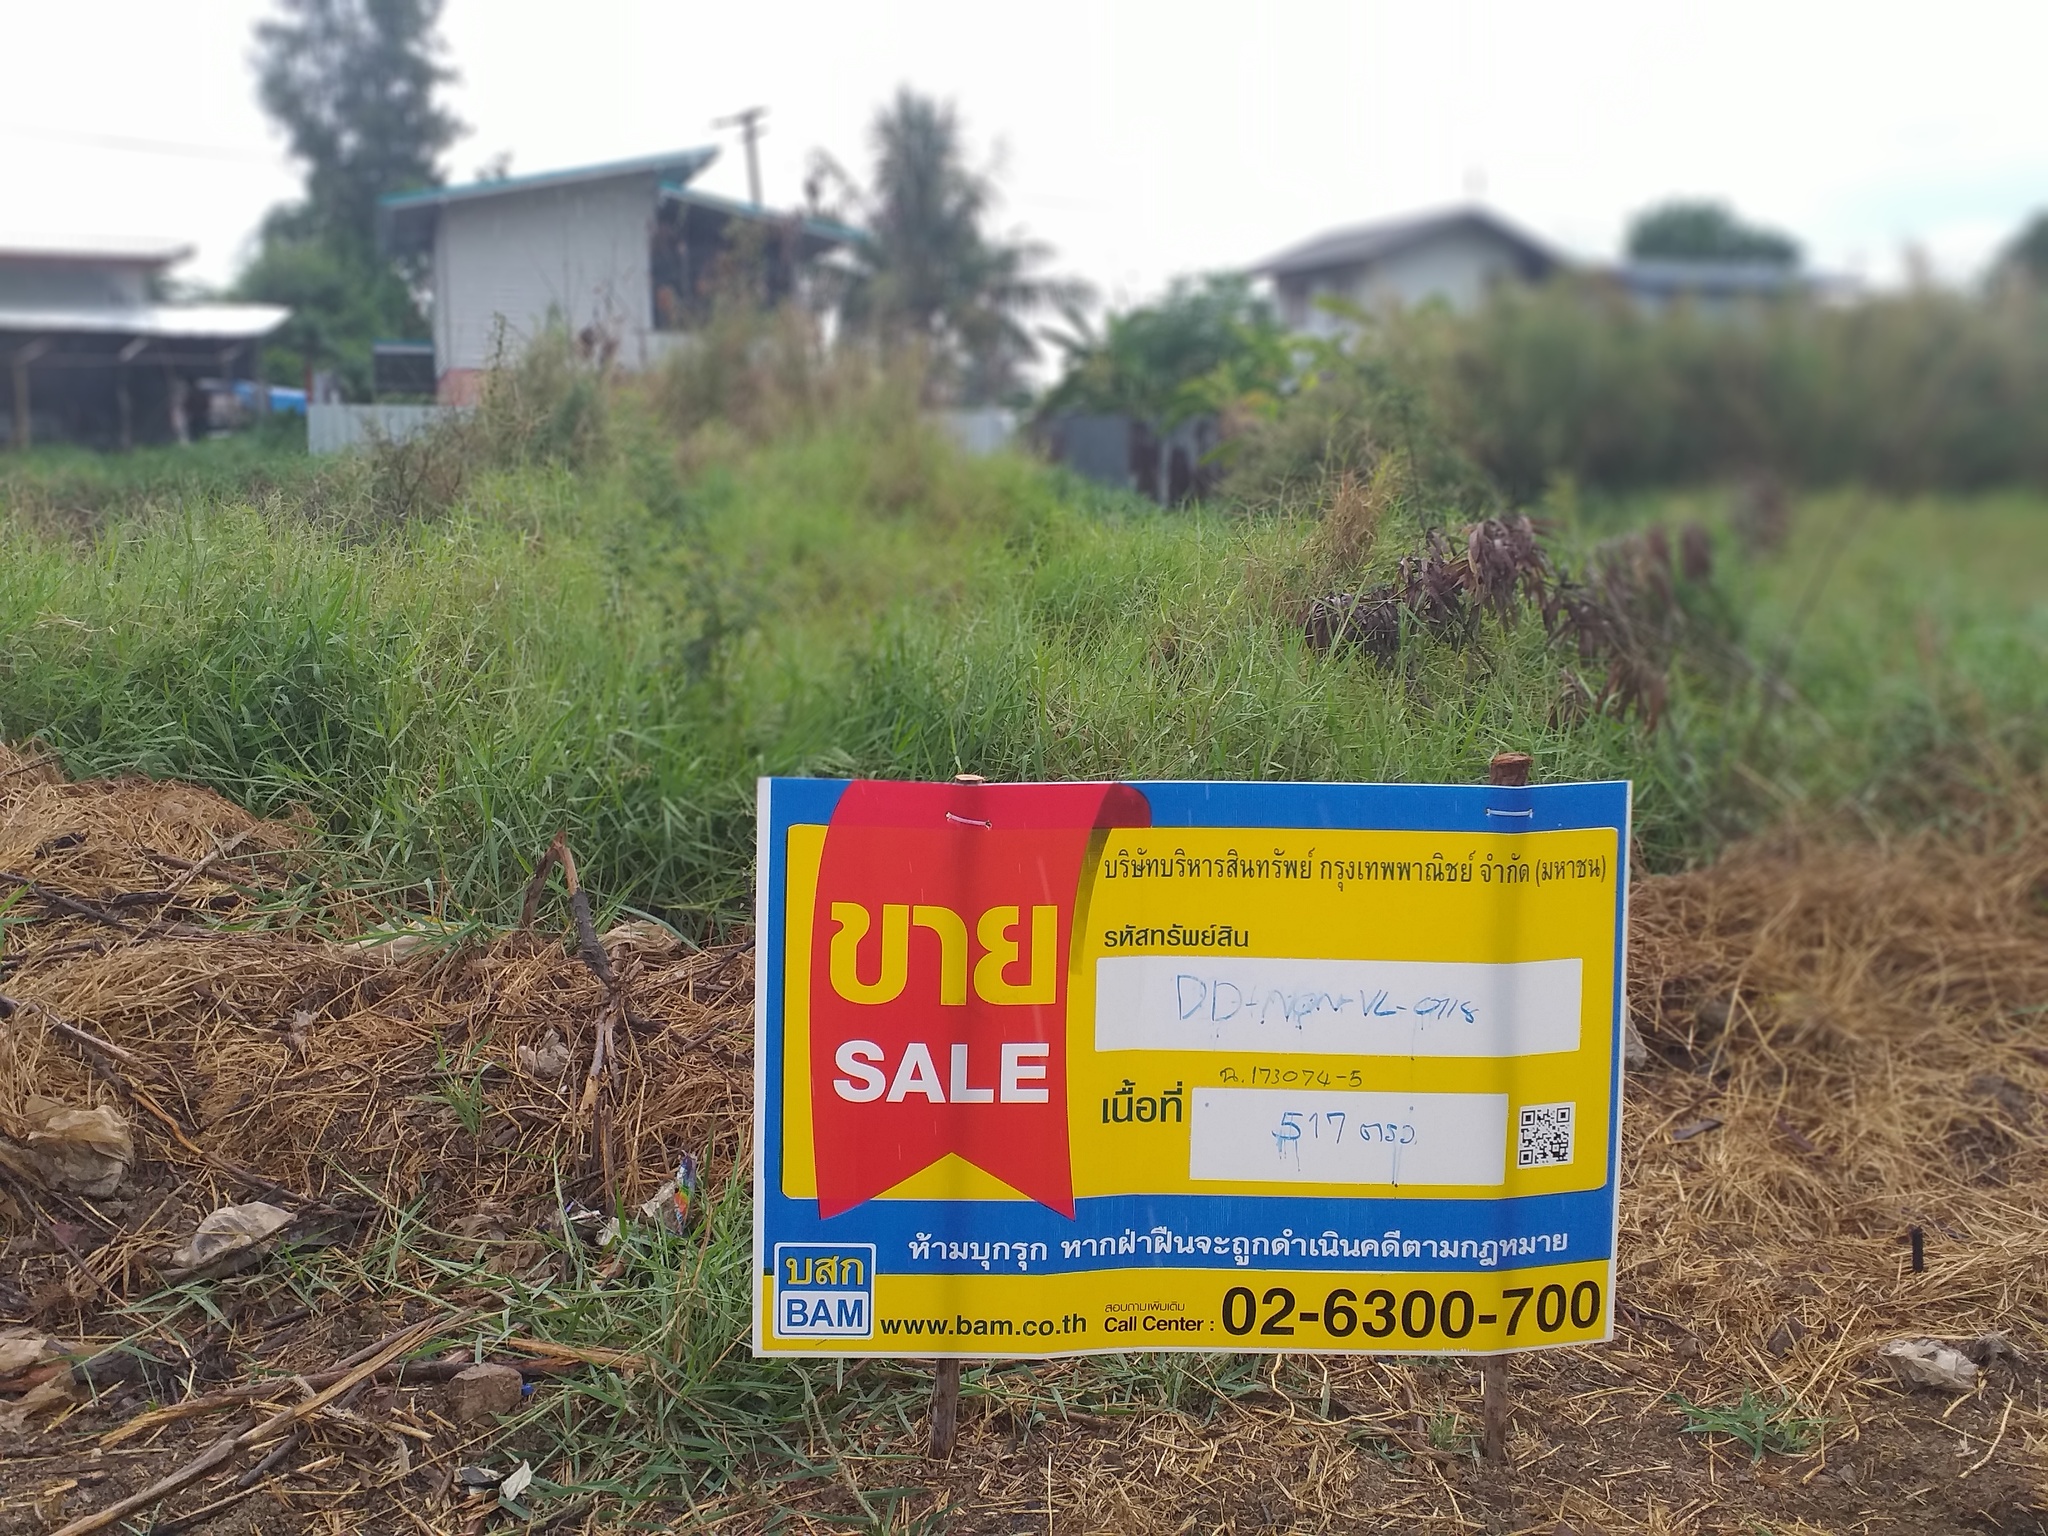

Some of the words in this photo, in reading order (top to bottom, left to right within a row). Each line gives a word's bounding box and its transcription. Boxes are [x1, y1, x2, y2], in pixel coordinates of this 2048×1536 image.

[1104, 847, 1316, 880] บริษัทบริหารสินทรัพย์
[1319, 850, 1476, 893] กรุงเทพพาณิชย์
[1479, 852, 1530, 884] จำกัด
[1535, 854, 1607, 888] (มหาชน)
[829, 901, 1058, 1006] ขาย
[1103, 924, 1249, 948] รหัสทรัพย์สิน
[832, 1039, 1050, 1104] SALE
[1101, 1079, 1184, 1124] เนื้อที่
[1271, 1111, 1346, 1145] 517
[907, 1232, 1048, 1272] ห้ามบุกรุก
[1060, 1225, 1568, 1267] หากฝ่าฝืนจะถูกดำเนินคดีตามกฎหมาย
[786, 1255, 864, 1286] บสก
[786, 1298, 864, 1329] BAM
[880, 1313, 1087, 1336] www.bam.co.th
[1104, 1316, 1137, 1333] Call
[1142, 1315, 1204, 1332] Center
[1221, 1280, 1600, 1339] 02-6300-700
